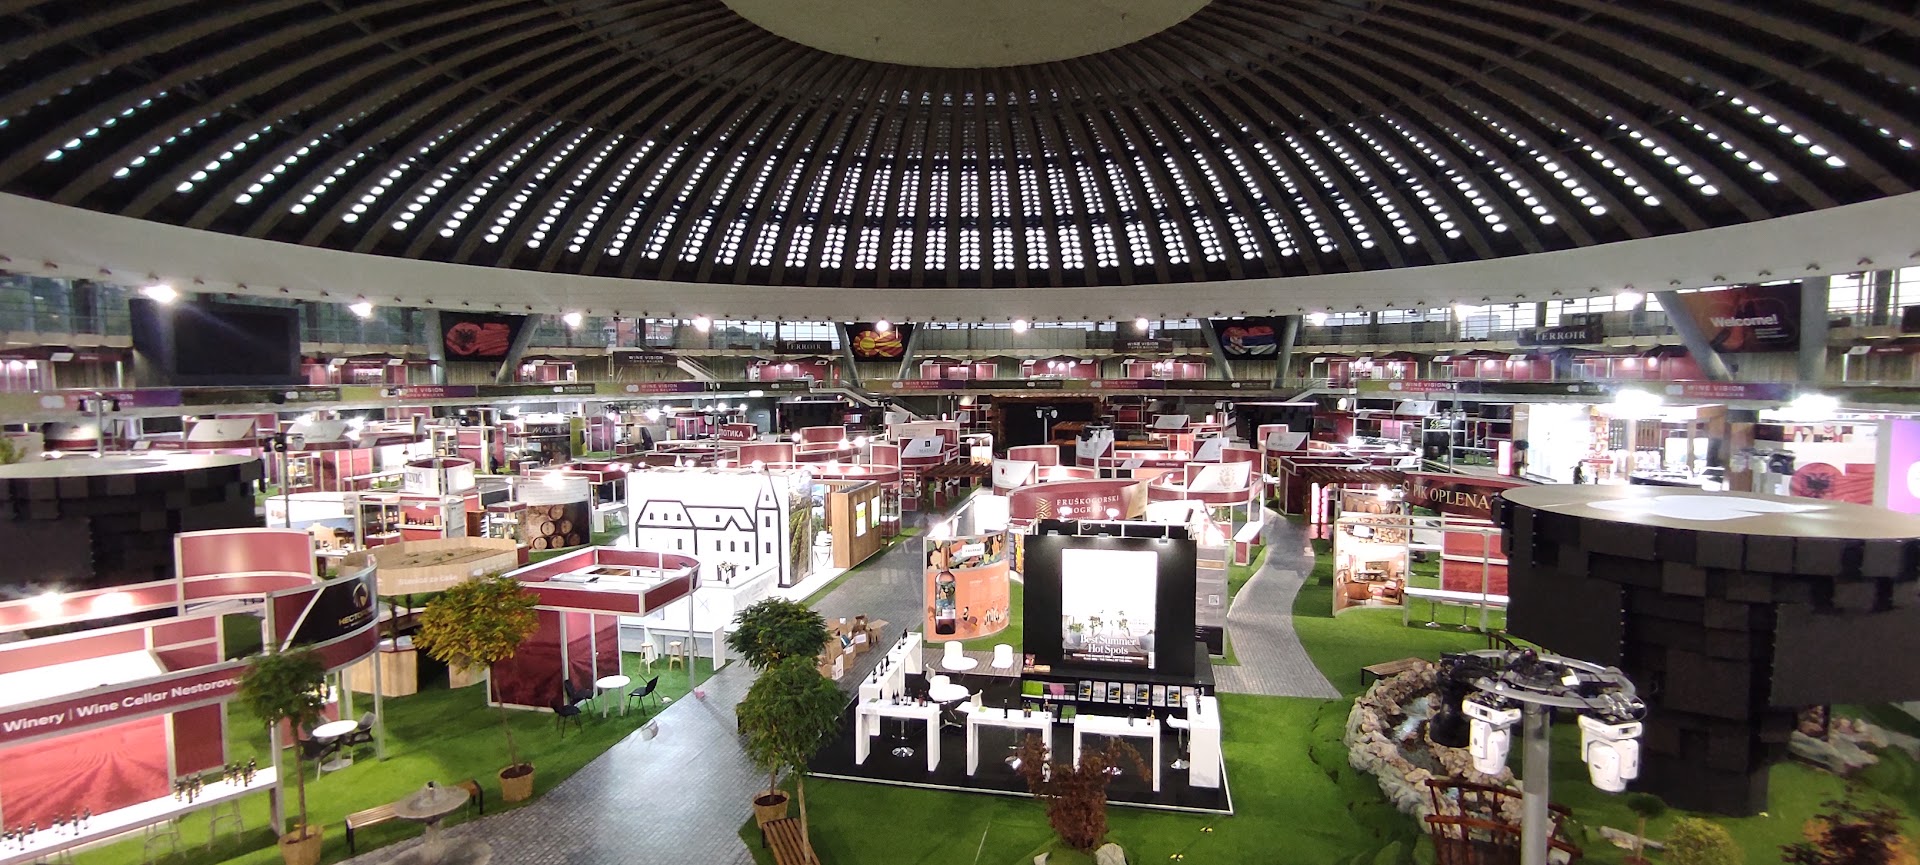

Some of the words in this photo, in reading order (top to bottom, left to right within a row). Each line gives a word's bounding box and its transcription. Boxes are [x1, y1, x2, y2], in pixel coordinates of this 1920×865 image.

[1710, 314, 1778, 327] Welcome!
[1535, 331, 1586, 341] TERROIR
[786, 341, 821, 350] TERROIR
[1413, 484, 1428, 500] PIK
[1056, 495, 1119, 506] FRUŠKOGORSKI
[1079, 634, 1100, 645] Best
[1100, 635, 1137, 647] Summer
[1087, 643, 1104, 653] Hot
[1104, 644, 1129, 657] Spots
[3, 713, 65, 732] Winery
[76, 702, 120, 718] Wine
[121, 691, 169, 708] Cellar
